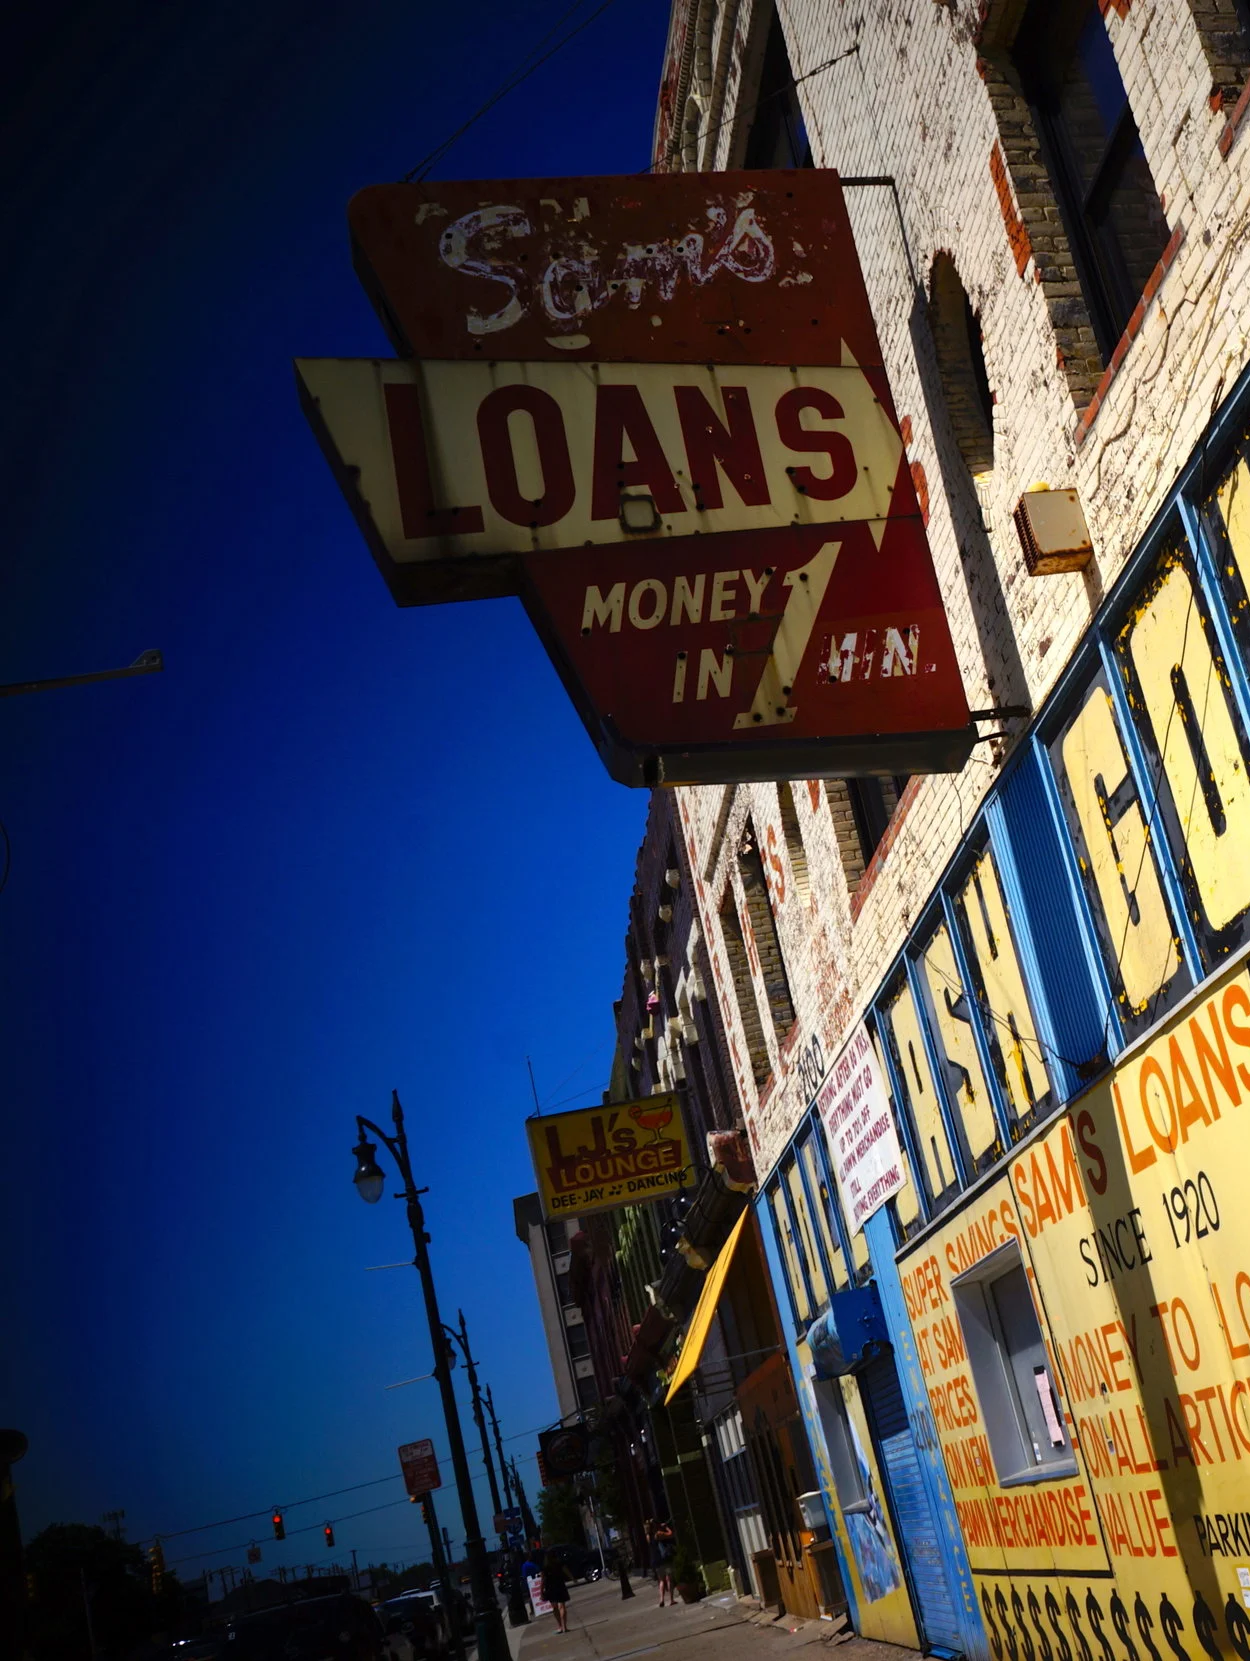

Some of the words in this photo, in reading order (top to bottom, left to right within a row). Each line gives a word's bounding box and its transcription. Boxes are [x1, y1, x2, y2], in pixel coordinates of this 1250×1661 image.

[384, 383, 858, 540] LOANS
[580, 566, 777, 635] MONEY
[672, 648, 734, 703] IN
[732, 541, 842, 730] 1
[863, 1064, 872, 1089] GO
[845, 1127, 853, 1146] TO
[860, 1103, 870, 1127] OFF
[855, 1112, 890, 1160] MERCHANDISE
[559, 1147, 677, 1188] LOUNGE
[626, 1170, 688, 1193] DANCING
[867, 1164, 900, 1207] EVERYTHING
[1014, 1110, 1107, 1238] SAM'S
[773, 1145, 870, 1321] GOL
[903, 1255, 949, 1321] SUPER
[945, 1200, 1022, 1277] SAVINGS
[1079, 1208, 1153, 1288] SINCE
[1162, 1171, 1220, 1250] 1920
[917, 1328, 935, 1378] AT
[1059, 1313, 1144, 1404] MONEY
[1150, 1297, 1200, 1376] TO
[929, 1375, 978, 1434] PRICES
[944, 1441, 968, 1489] ON
[963, 1434, 996, 1487] NEW
[1079, 1413, 1114, 1479] ON
[1109, 1403, 1168, 1477] ALL
[956, 1498, 994, 1548] PAWN
[988, 1485, 1098, 1549] MERCHANDISE
[1096, 1488, 1178, 1557] VALUE
